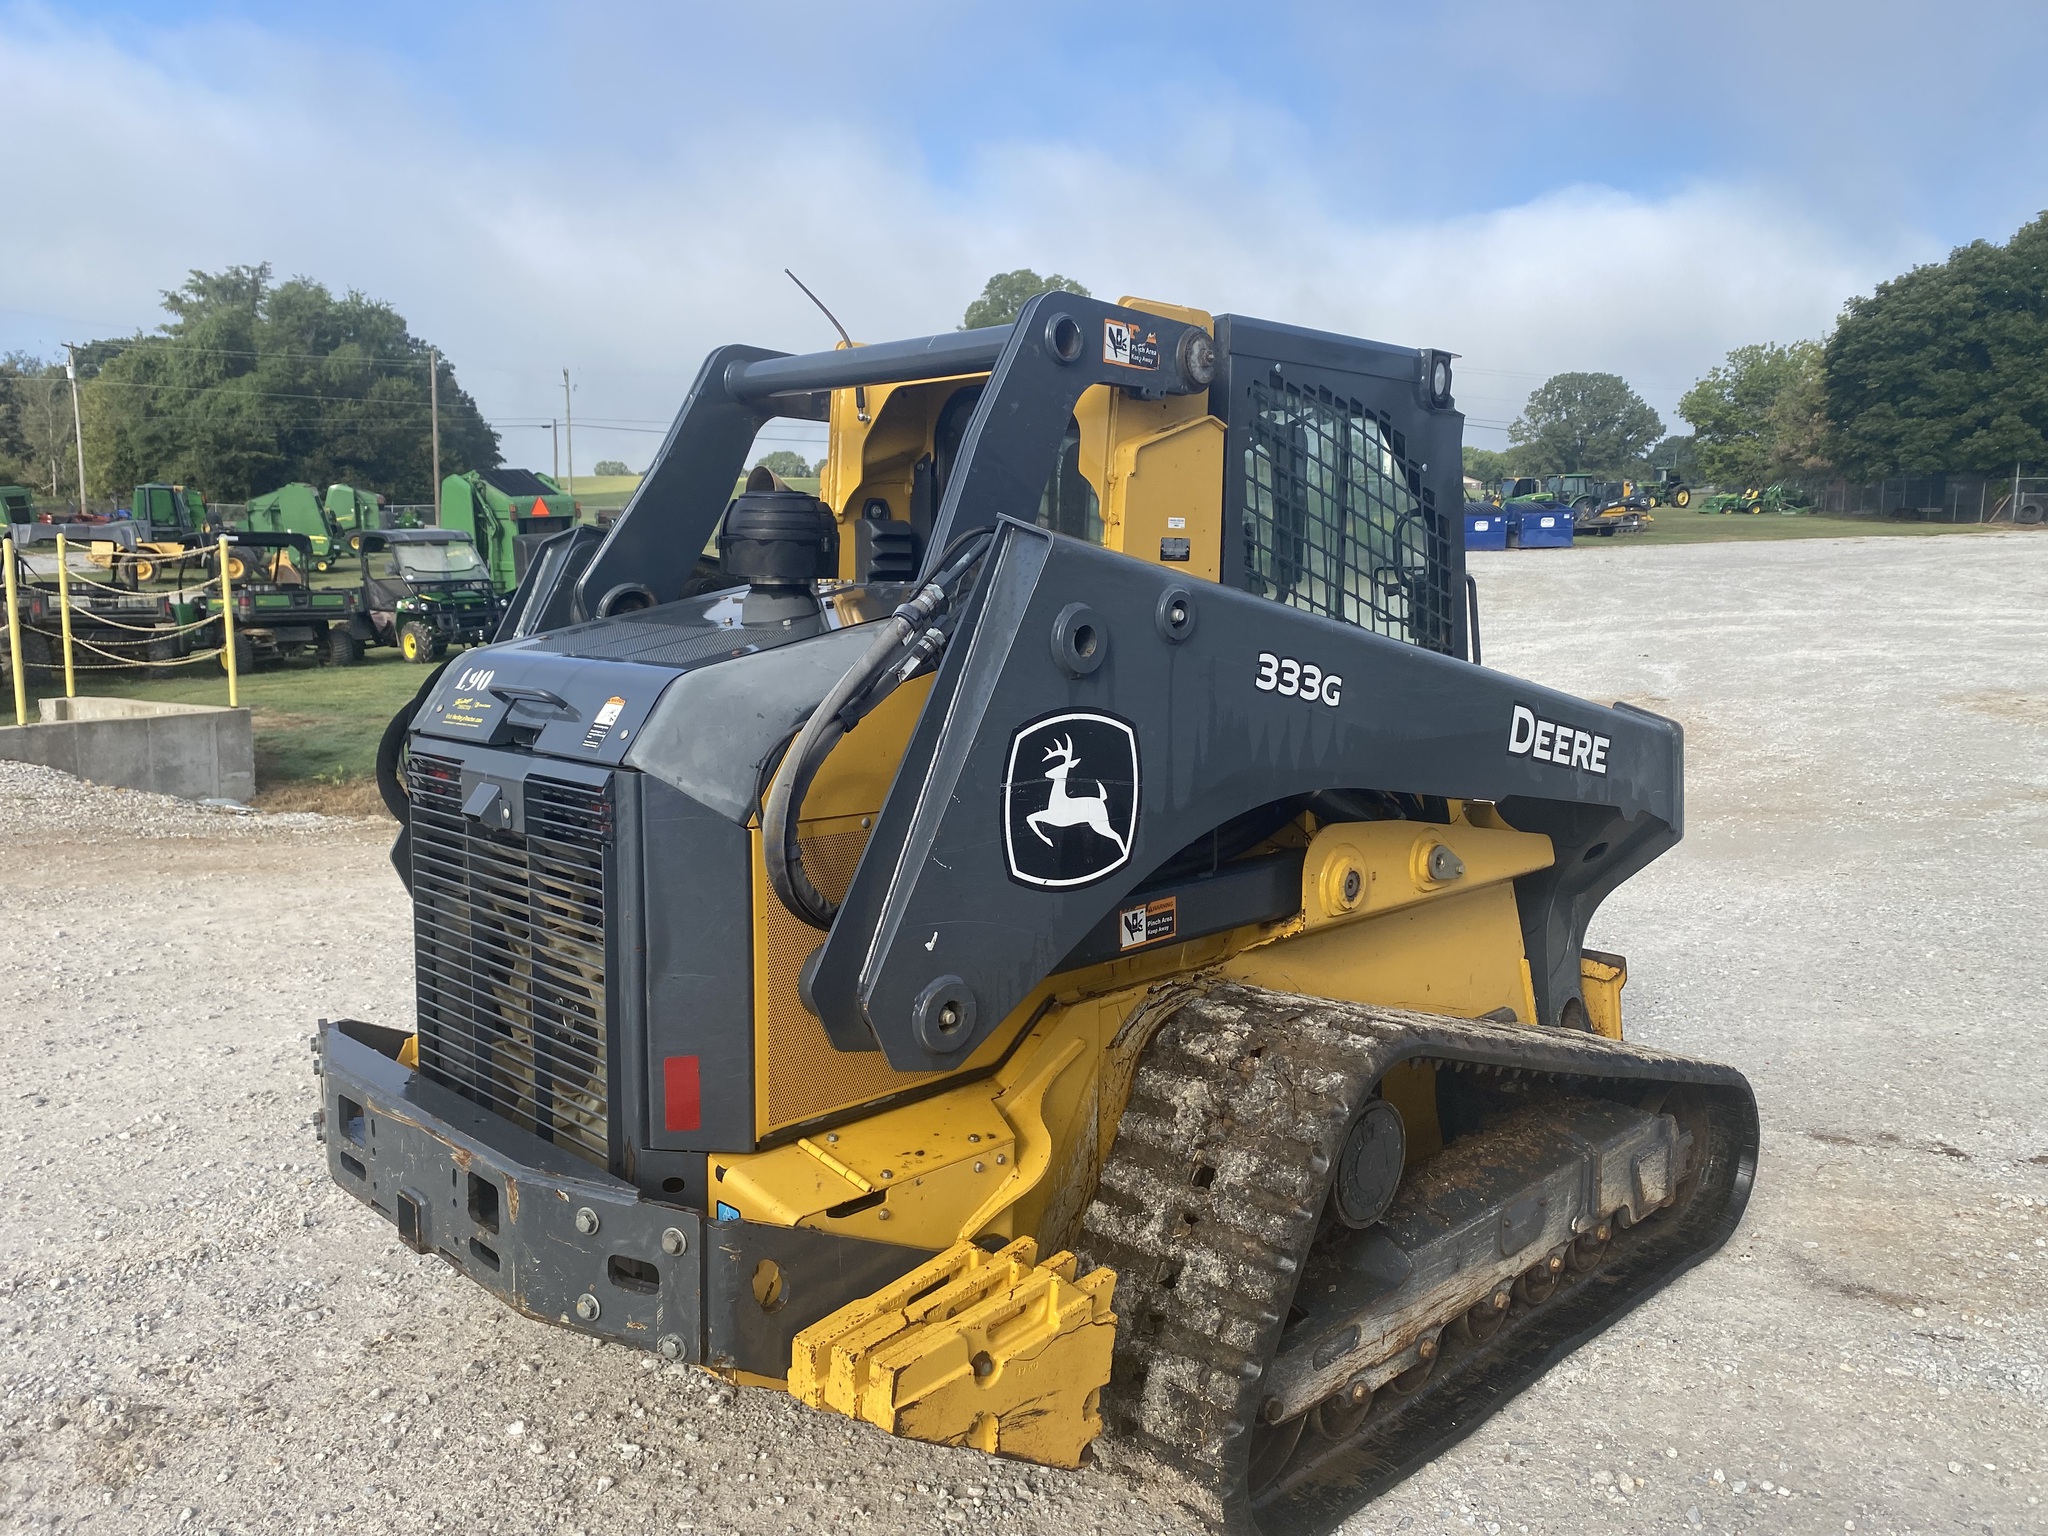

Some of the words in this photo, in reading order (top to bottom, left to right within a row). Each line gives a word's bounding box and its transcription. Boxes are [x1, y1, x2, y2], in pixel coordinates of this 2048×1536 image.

[1145, 347, 1157, 355] Area
[1255, 653, 1342, 707] 333G
[1508, 705, 1610, 774] DEERE
[1151, 902, 1173, 910] WARNING
